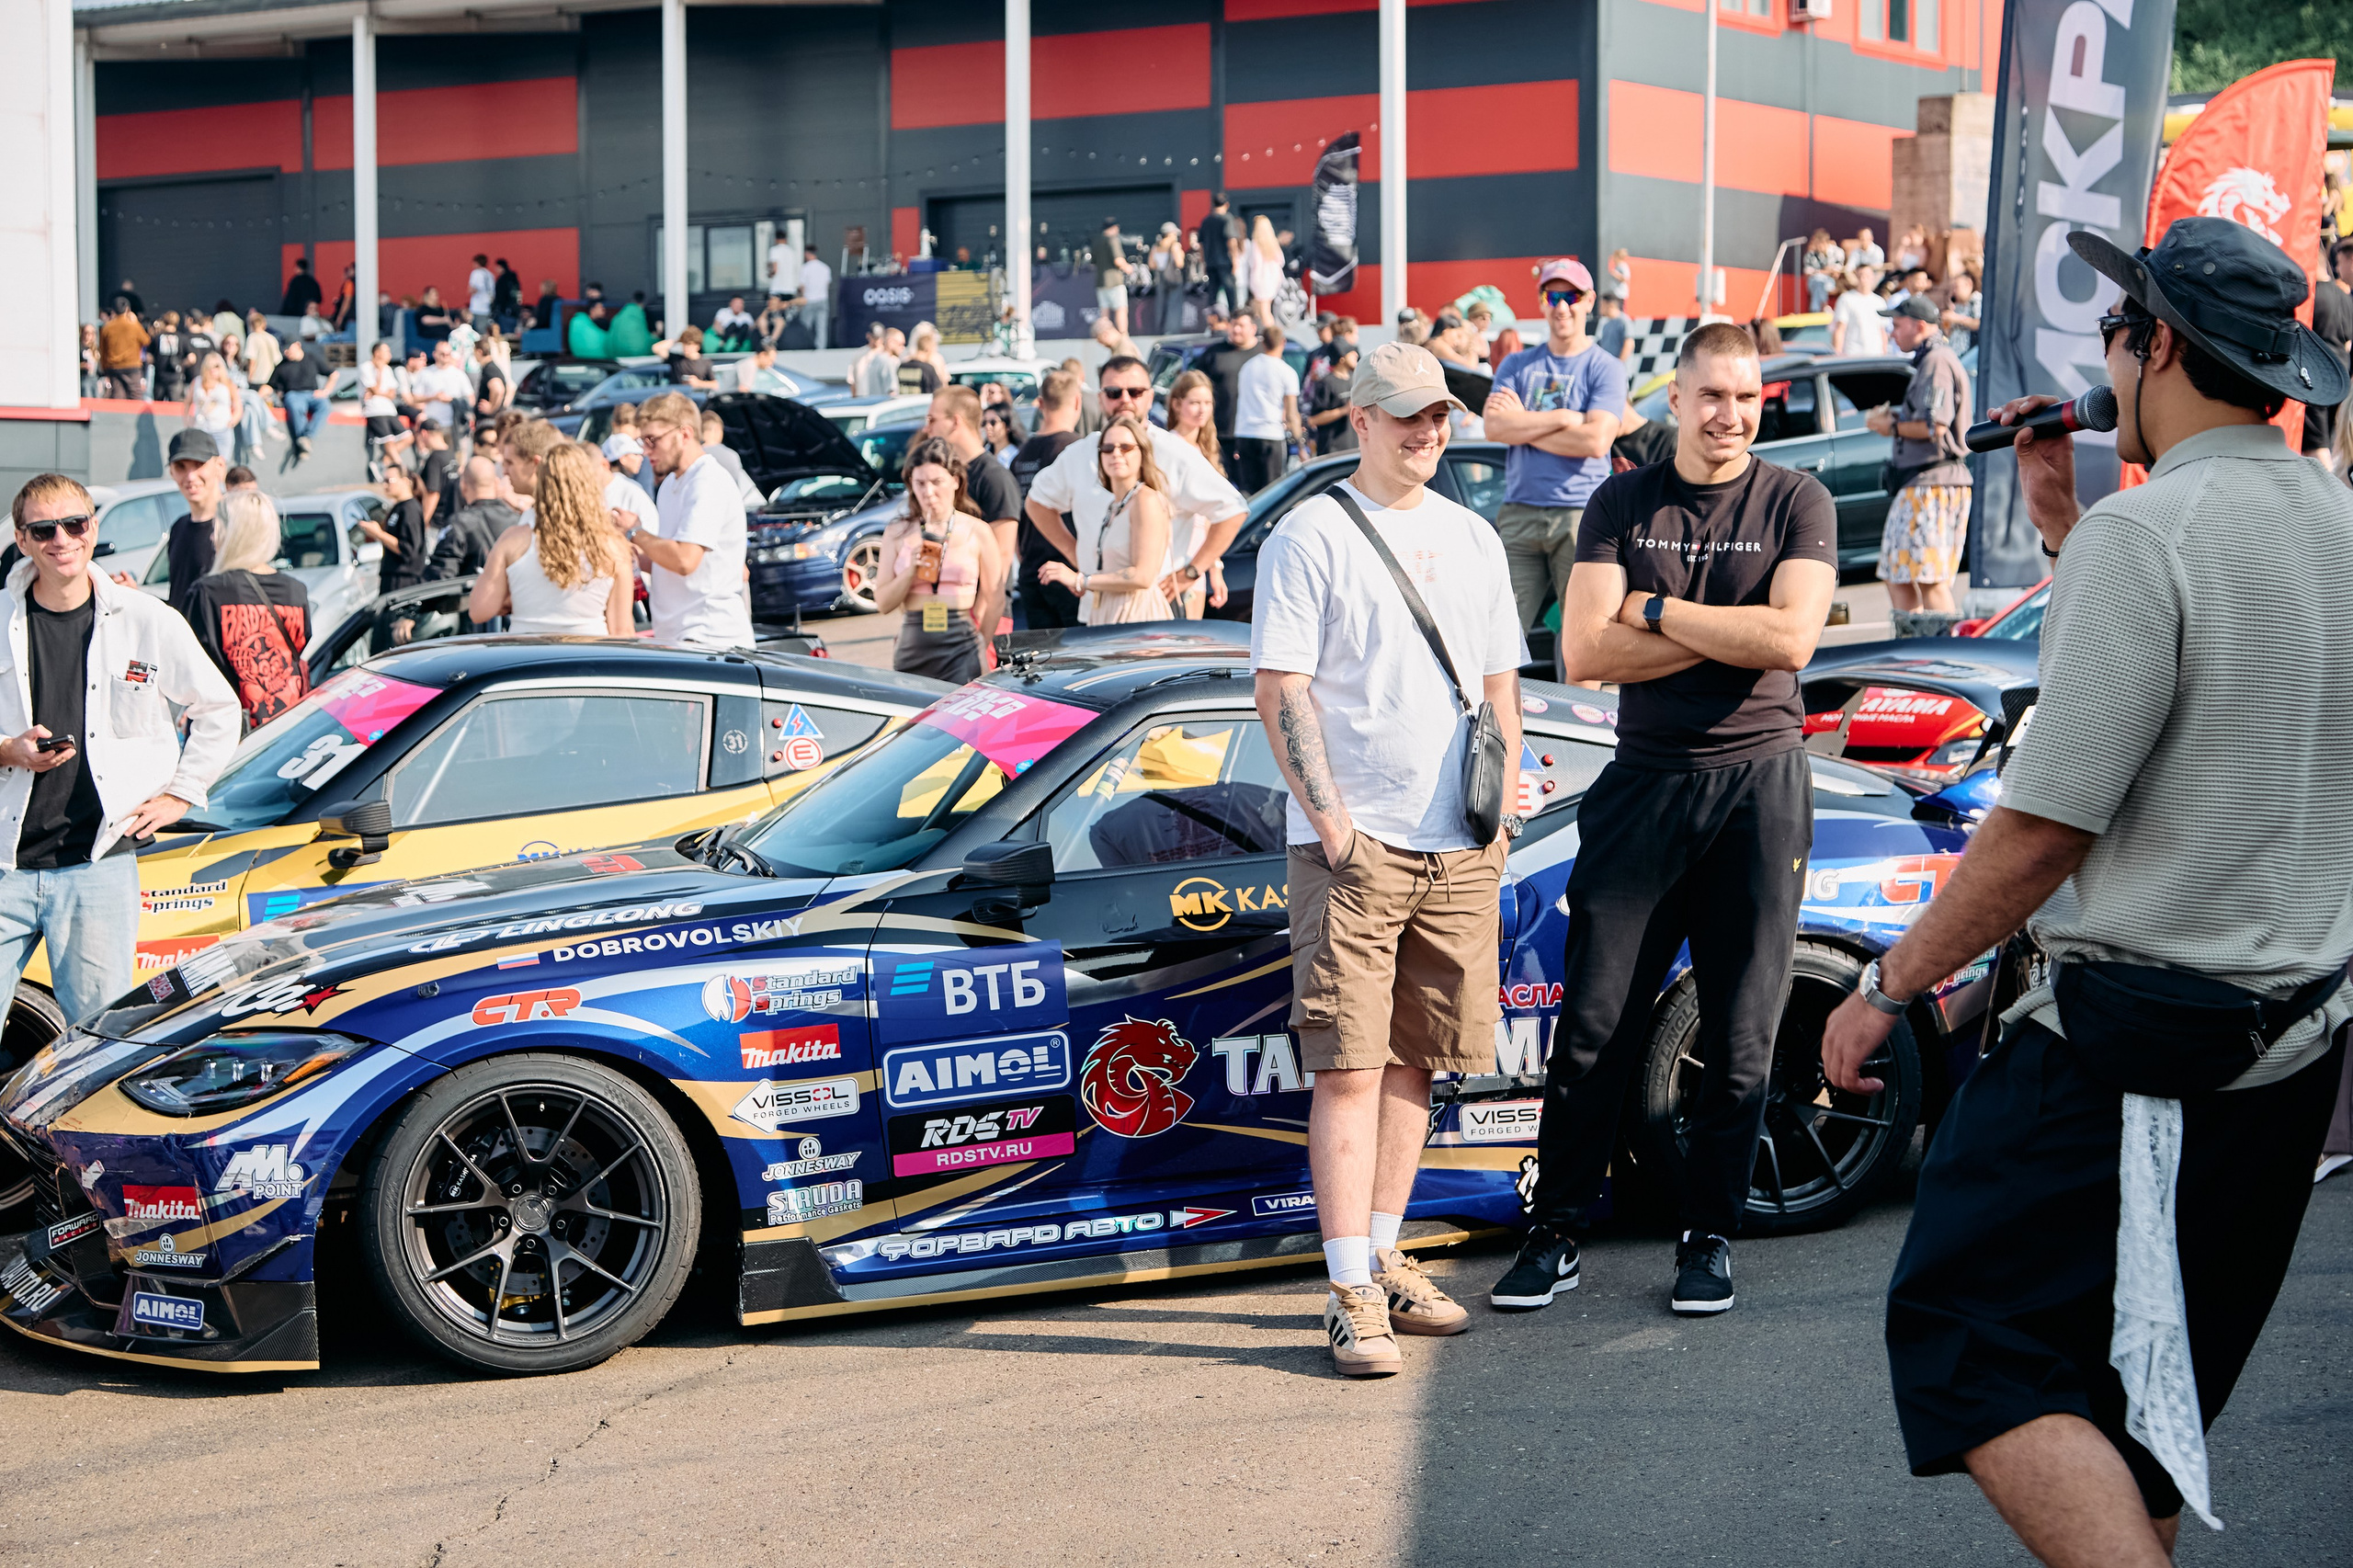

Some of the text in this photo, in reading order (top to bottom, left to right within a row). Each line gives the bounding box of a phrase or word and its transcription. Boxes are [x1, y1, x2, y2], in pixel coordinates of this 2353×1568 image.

[1636, 538, 1762, 552] TOMMY HILFIGER
[727, 734, 744, 749] 31
[793, 744, 814, 760] E
[276, 733, 369, 791] 31
[141, 881, 228, 898] Standard
[141, 897, 214, 913] Springs
[495, 901, 704, 939] LINGLONG
[552, 917, 803, 963] DOBROVOLSKIY
[752, 967, 858, 992] Standard
[942, 960, 1046, 1016] ВТБ
[472, 989, 582, 1025] CTR
[754, 989, 841, 1016] Springs
[741, 1040, 842, 1069] makita
[893, 1045, 1063, 1096] AIMOL
[752, 1086, 849, 1108] VISSOL
[753, 1100, 850, 1119] FORGED WHEELS
[920, 1106, 1044, 1148] RDS TV
[1471, 1126, 1522, 1136] FORGED
[936, 1142, 1033, 1166] RDSTV.RU
[764, 1153, 859, 1181] JONNESWAY
[255, 1183, 302, 1198] POINT
[767, 1179, 862, 1212] SIRUDA
[124, 1199, 201, 1221] makita
[770, 1201, 862, 1223] Performance Gaskets
[51, 1213, 99, 1238] FORWARD
[54, 1222, 97, 1244] RACING
[880, 1212, 1164, 1262] ФОРВАРД АВТО
[135, 1251, 204, 1267] JONNESWAY
[137, 1297, 200, 1324] AIMOL
